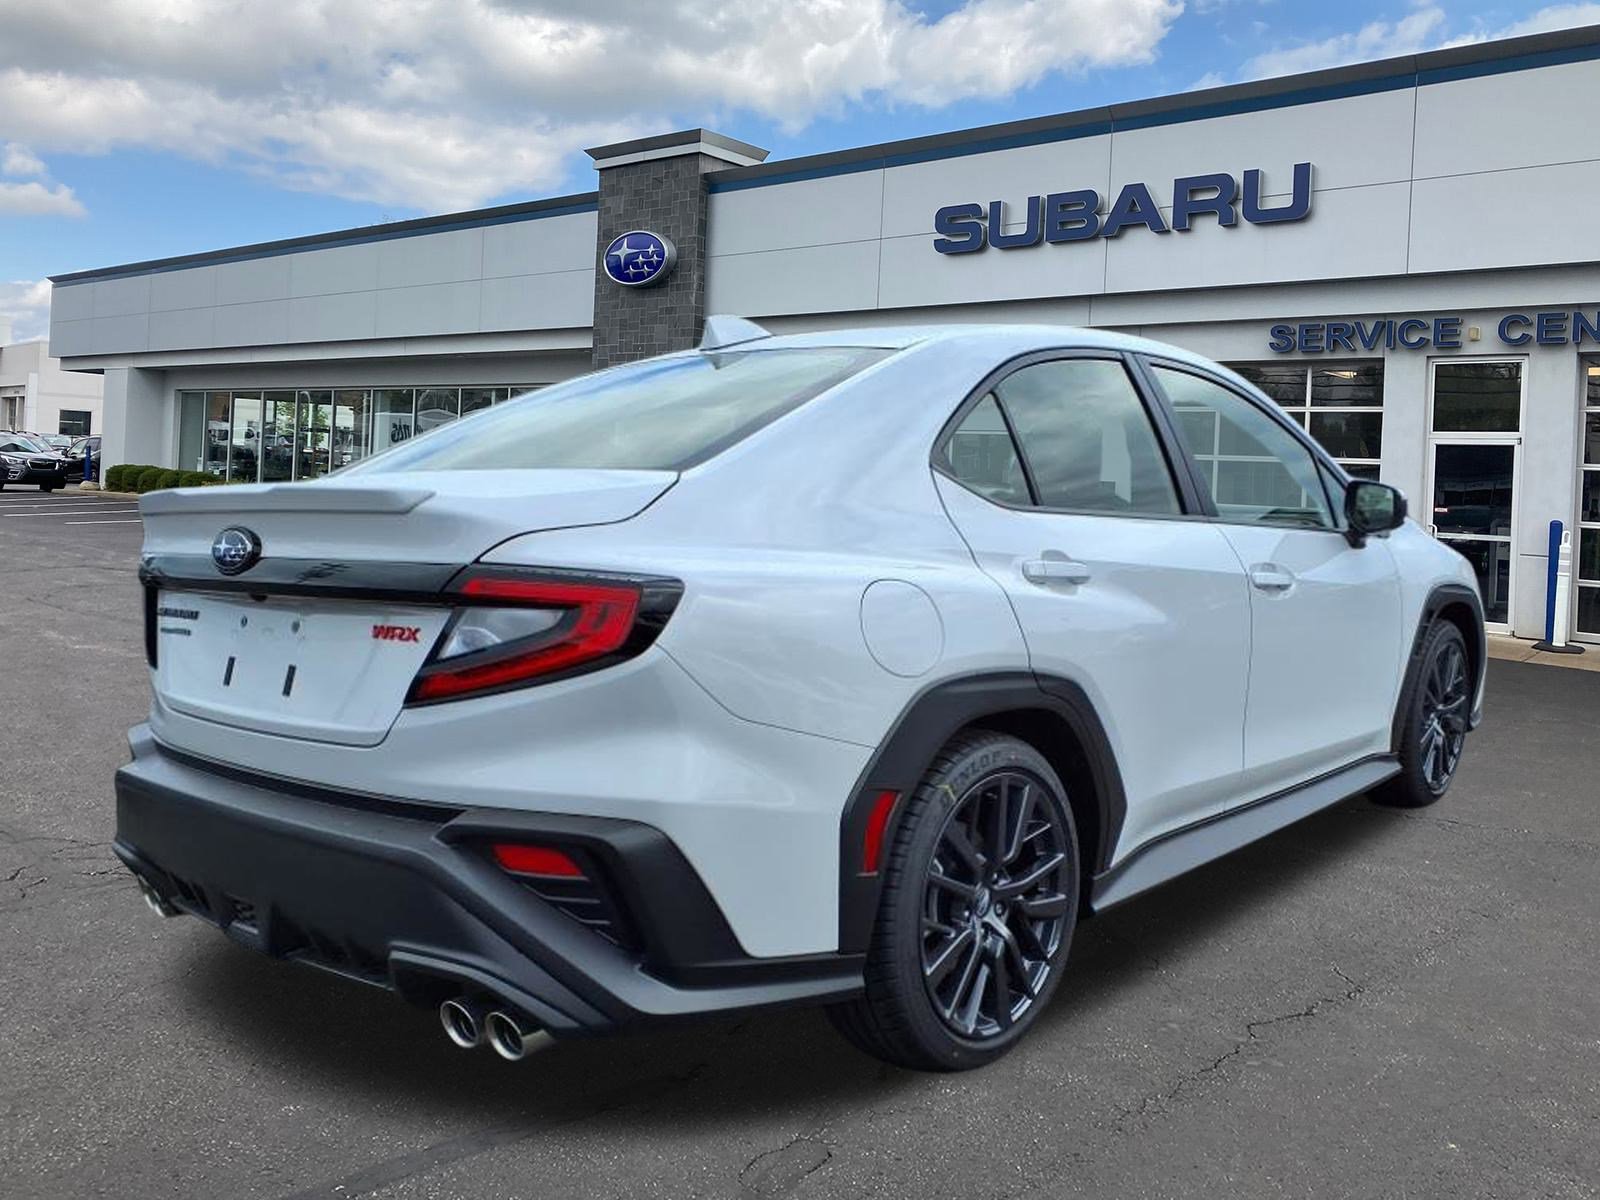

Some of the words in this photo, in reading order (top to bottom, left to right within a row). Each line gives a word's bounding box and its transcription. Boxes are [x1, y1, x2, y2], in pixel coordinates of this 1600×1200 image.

[934, 162, 1313, 255] SUBARU
[1269, 317, 1463, 353] SERVICE
[1497, 311, 1600, 346] CEN
[372, 625, 421, 643] WRX
